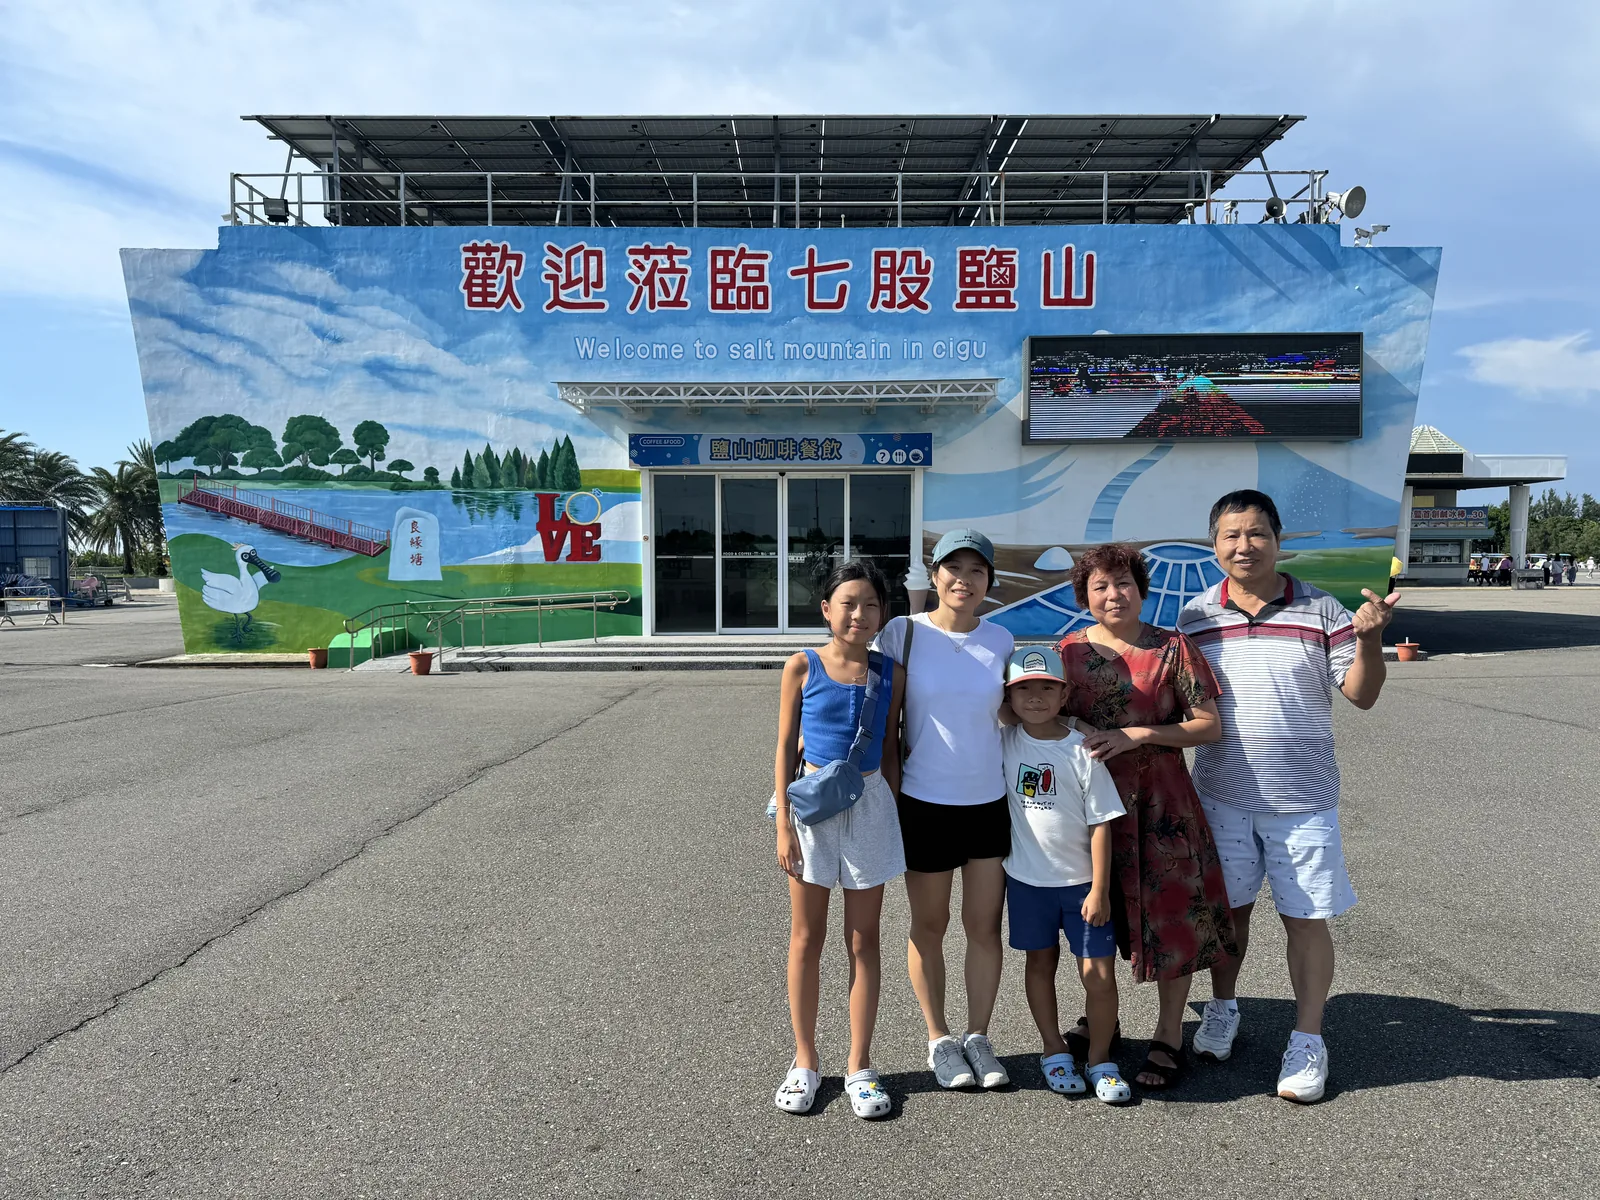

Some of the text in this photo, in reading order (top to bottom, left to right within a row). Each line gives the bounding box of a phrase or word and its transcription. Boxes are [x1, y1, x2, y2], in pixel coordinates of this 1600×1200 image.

[460, 241, 1096, 313] 歡迎蒞臨七股鹽山
[575, 336, 987, 362] Welcome to salt mountain in cigu
[710, 438, 842, 460] 鹽山咖啡餐飲
